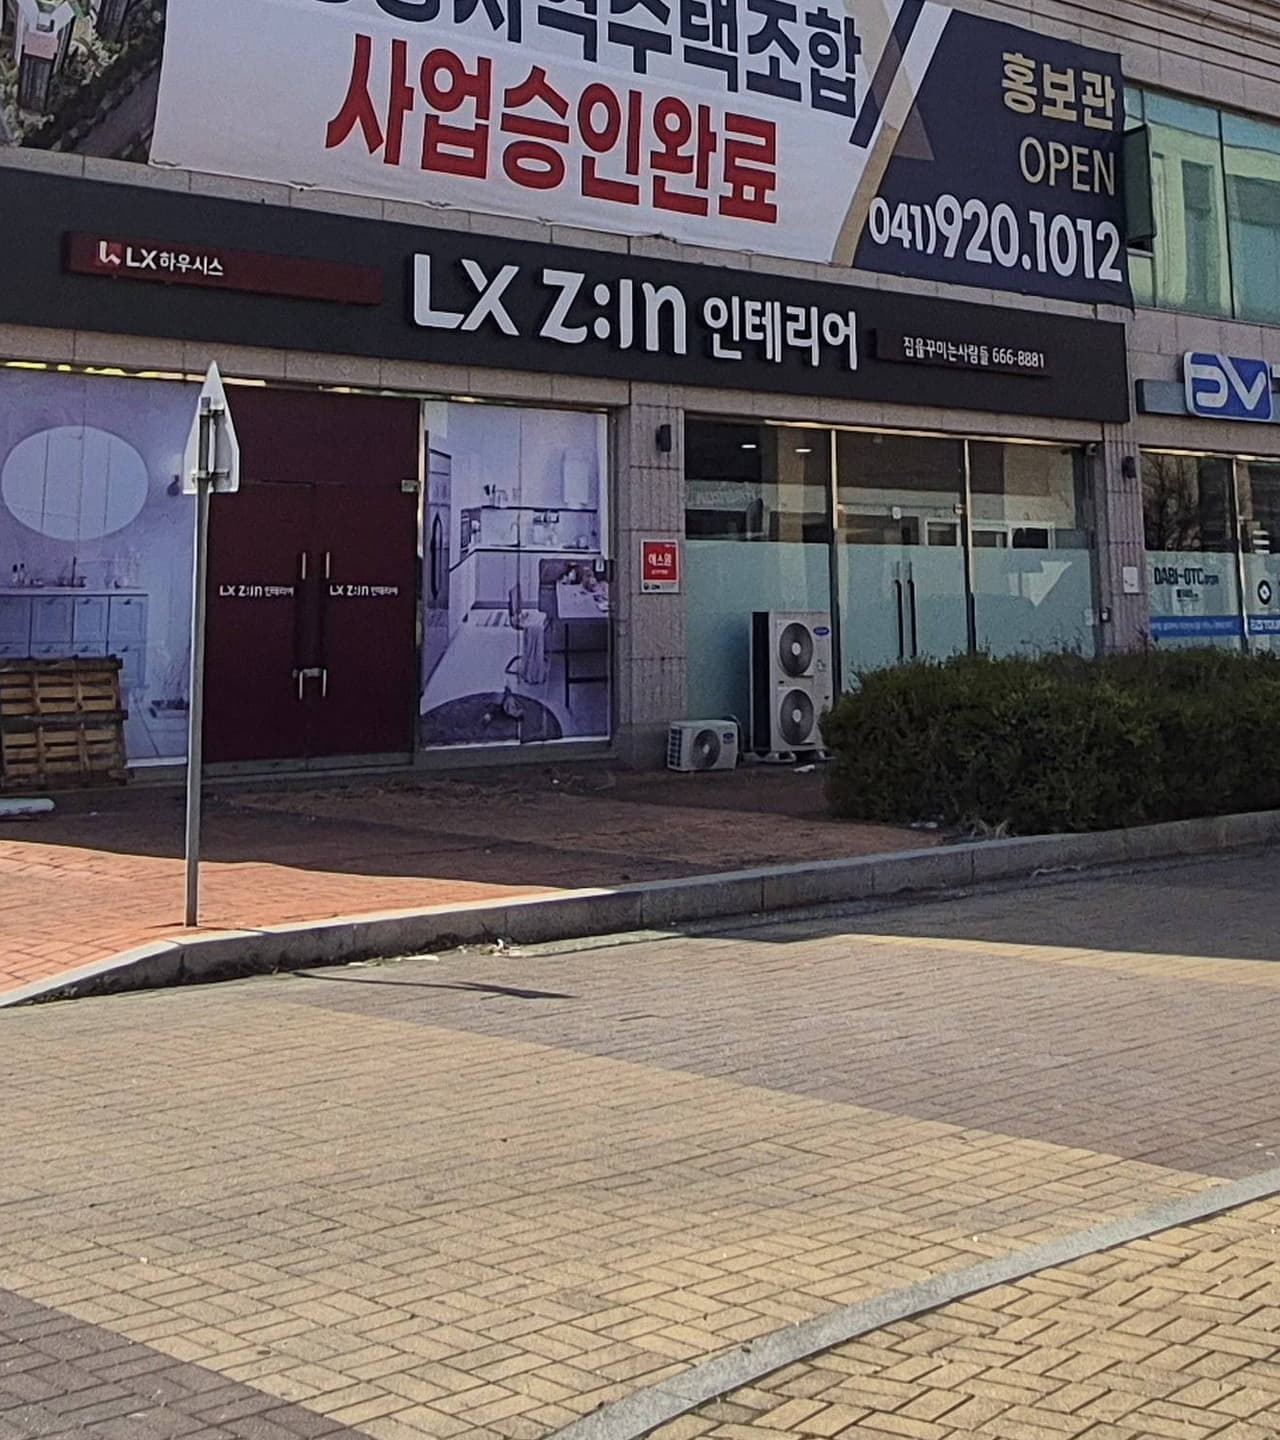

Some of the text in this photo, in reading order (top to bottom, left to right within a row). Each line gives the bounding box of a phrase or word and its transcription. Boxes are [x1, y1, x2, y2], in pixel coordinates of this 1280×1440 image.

[325, 33, 780, 224] 사업승인완료
[1001, 52, 1115, 130] 홍보관
[1019, 136, 1115, 196] OPEN
[869, 193, 1122, 282] 041)920.1012
[413, 253, 520, 336] LX
[703, 295, 858, 370] 인테리어
[219, 585, 236, 596] LX
[329, 585, 344, 596] LX
